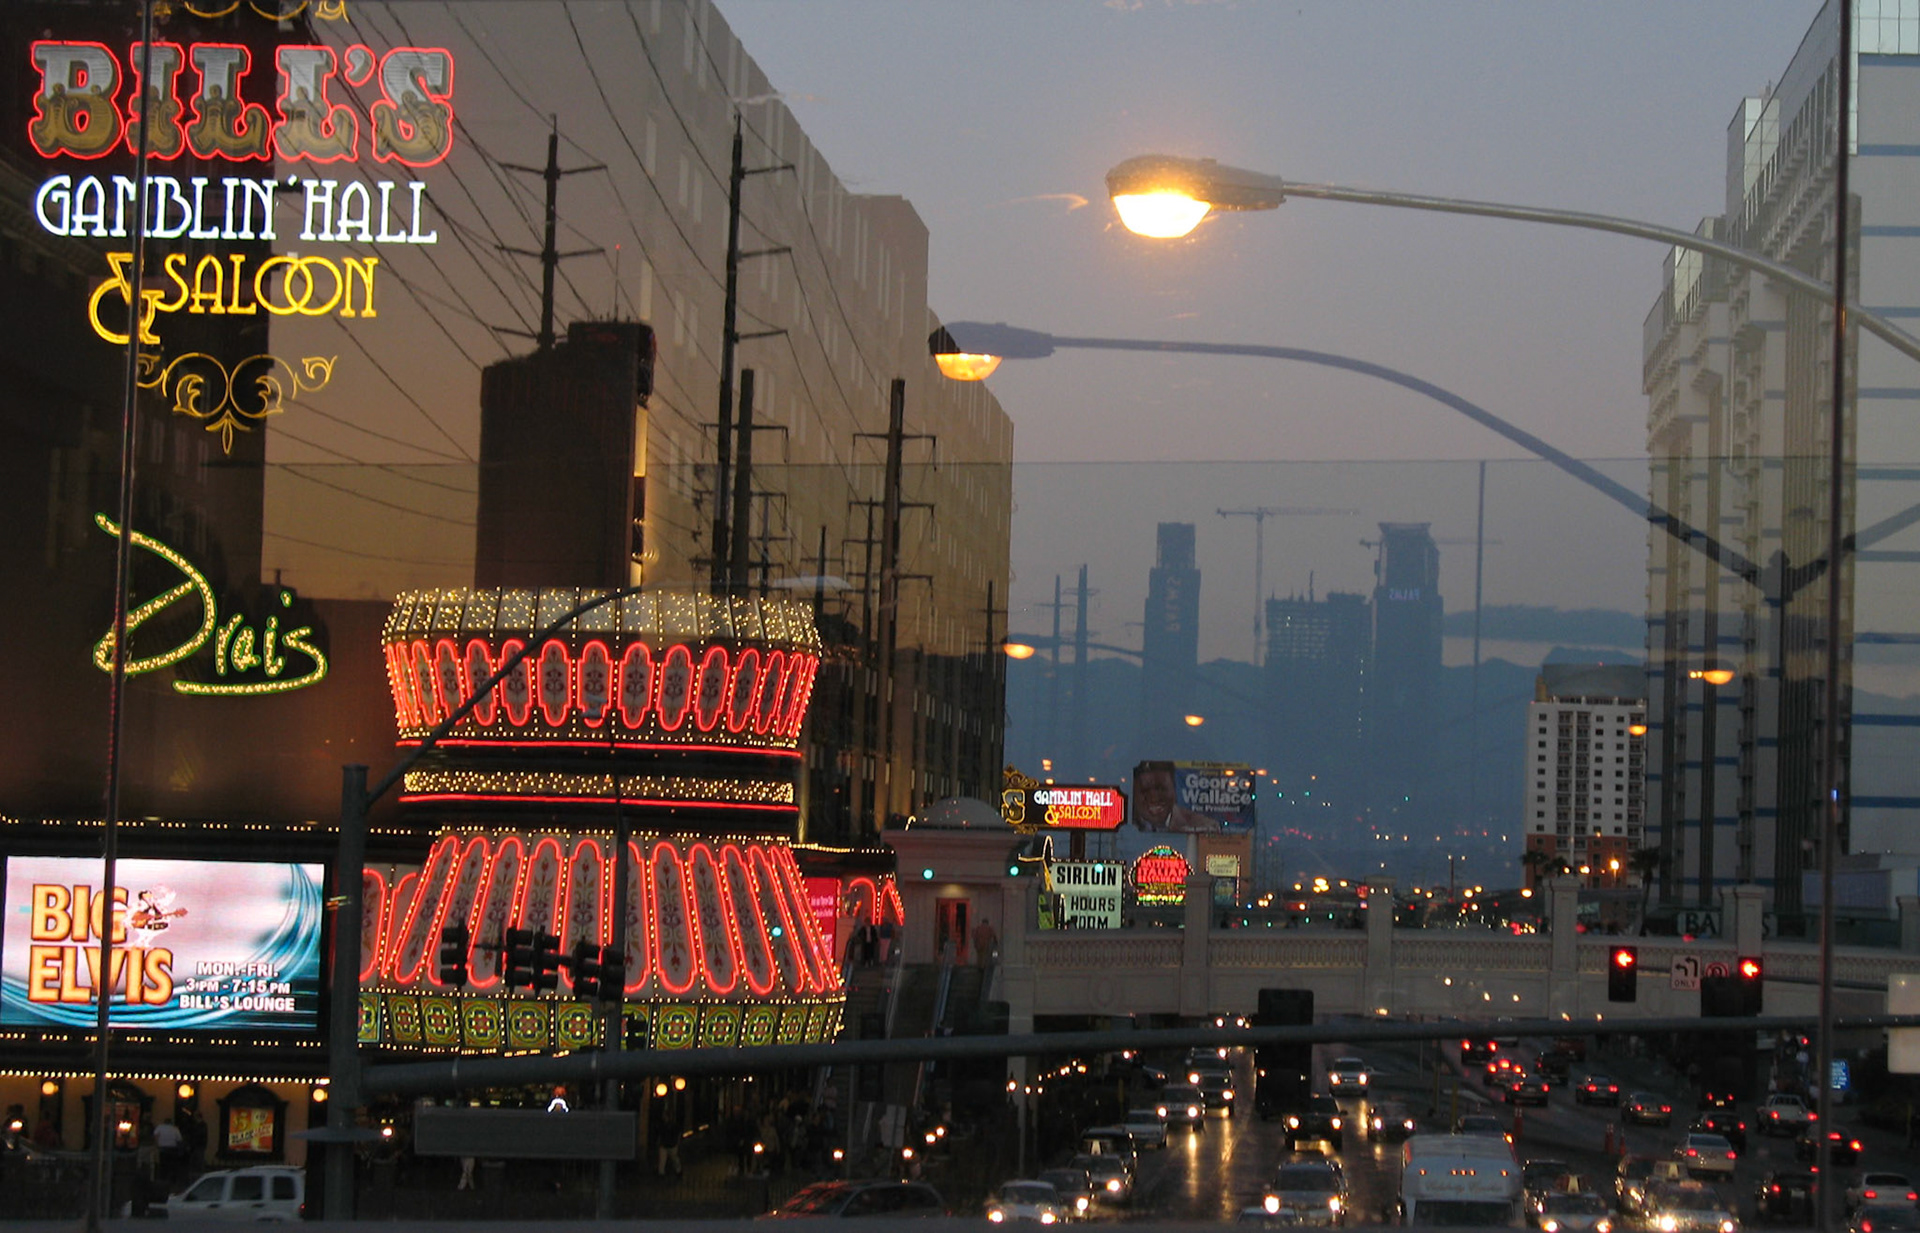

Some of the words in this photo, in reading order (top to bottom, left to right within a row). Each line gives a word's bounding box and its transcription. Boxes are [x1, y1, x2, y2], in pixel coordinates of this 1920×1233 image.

[28, 41, 454, 167] BILL'S
[36, 174, 298, 240] GAMBLIN'
[299, 179, 438, 244] HALL
[89, 252, 163, 344] &
[154, 254, 379, 318] SALOON
[1185, 774, 1251, 792] George
[1085, 792, 1113, 806] HALL
[1182, 789, 1252, 805] Wallace
[1045, 805, 1059, 824] &
[1058, 806, 1101, 820] SALOON
[1056, 866, 1117, 885] SIRLOIN
[1137, 867, 1188, 877] ITALIAN
[1071, 896, 1115, 911] HOURS
[31, 884, 129, 943] BIG
[28, 945, 173, 1005] ELVIS
[1674, 979, 1695, 988] ONLY
[186, 978, 195, 991] 3
[200, 981, 219, 991] PM
[232, 979, 268, 993] 7:15
[269, 983, 290, 994] PM
[180, 995, 229, 1009] BILL'S
[234, 996, 295, 1011] LOUNGE
